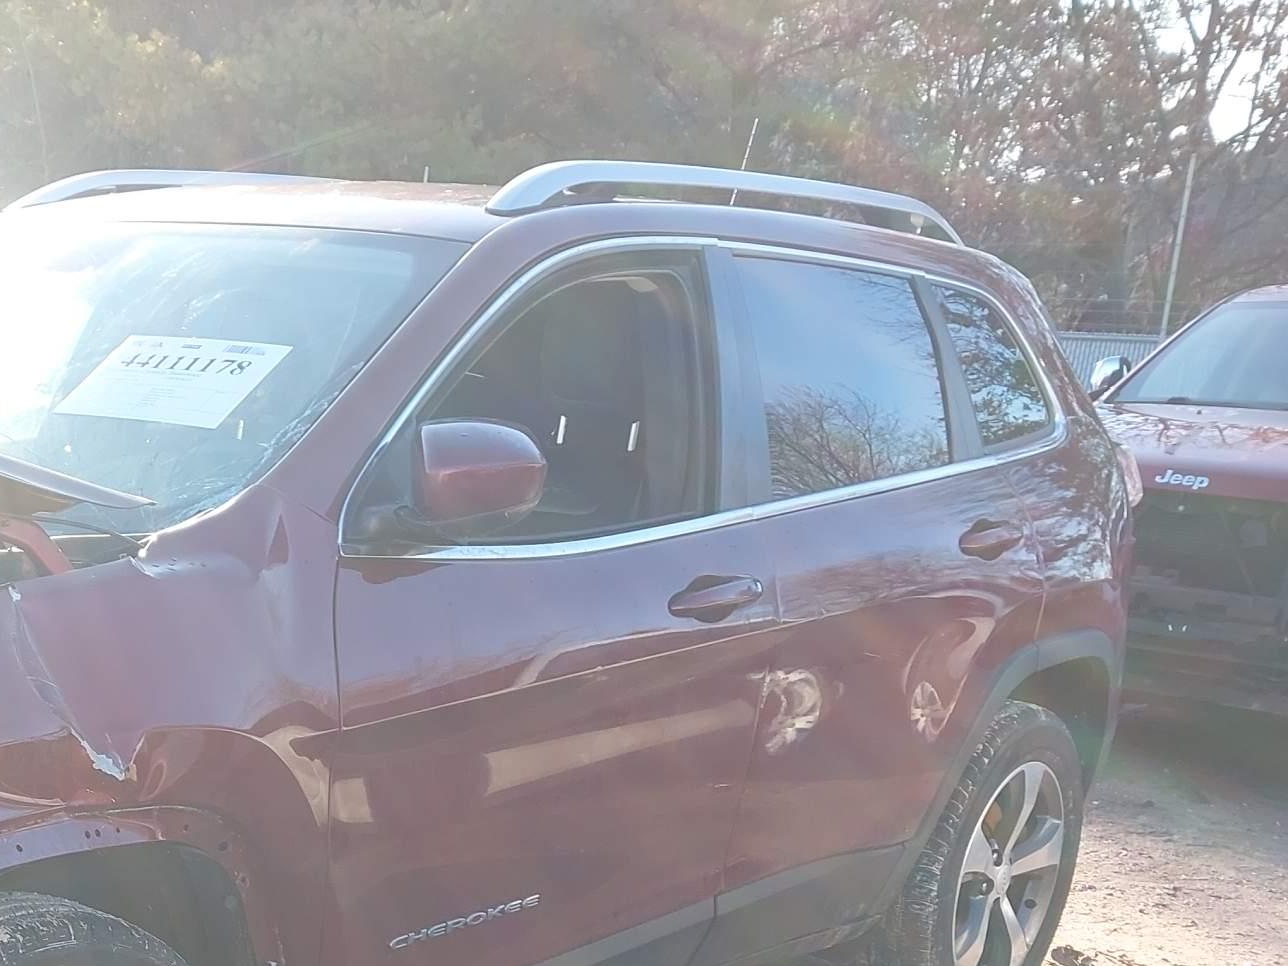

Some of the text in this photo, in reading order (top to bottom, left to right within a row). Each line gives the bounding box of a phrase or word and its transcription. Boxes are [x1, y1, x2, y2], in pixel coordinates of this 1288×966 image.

[121, 353, 253, 376] 44111178
[1155, 469, 1209, 490] Jeep
[389, 894, 541, 949] CHEROKEE
